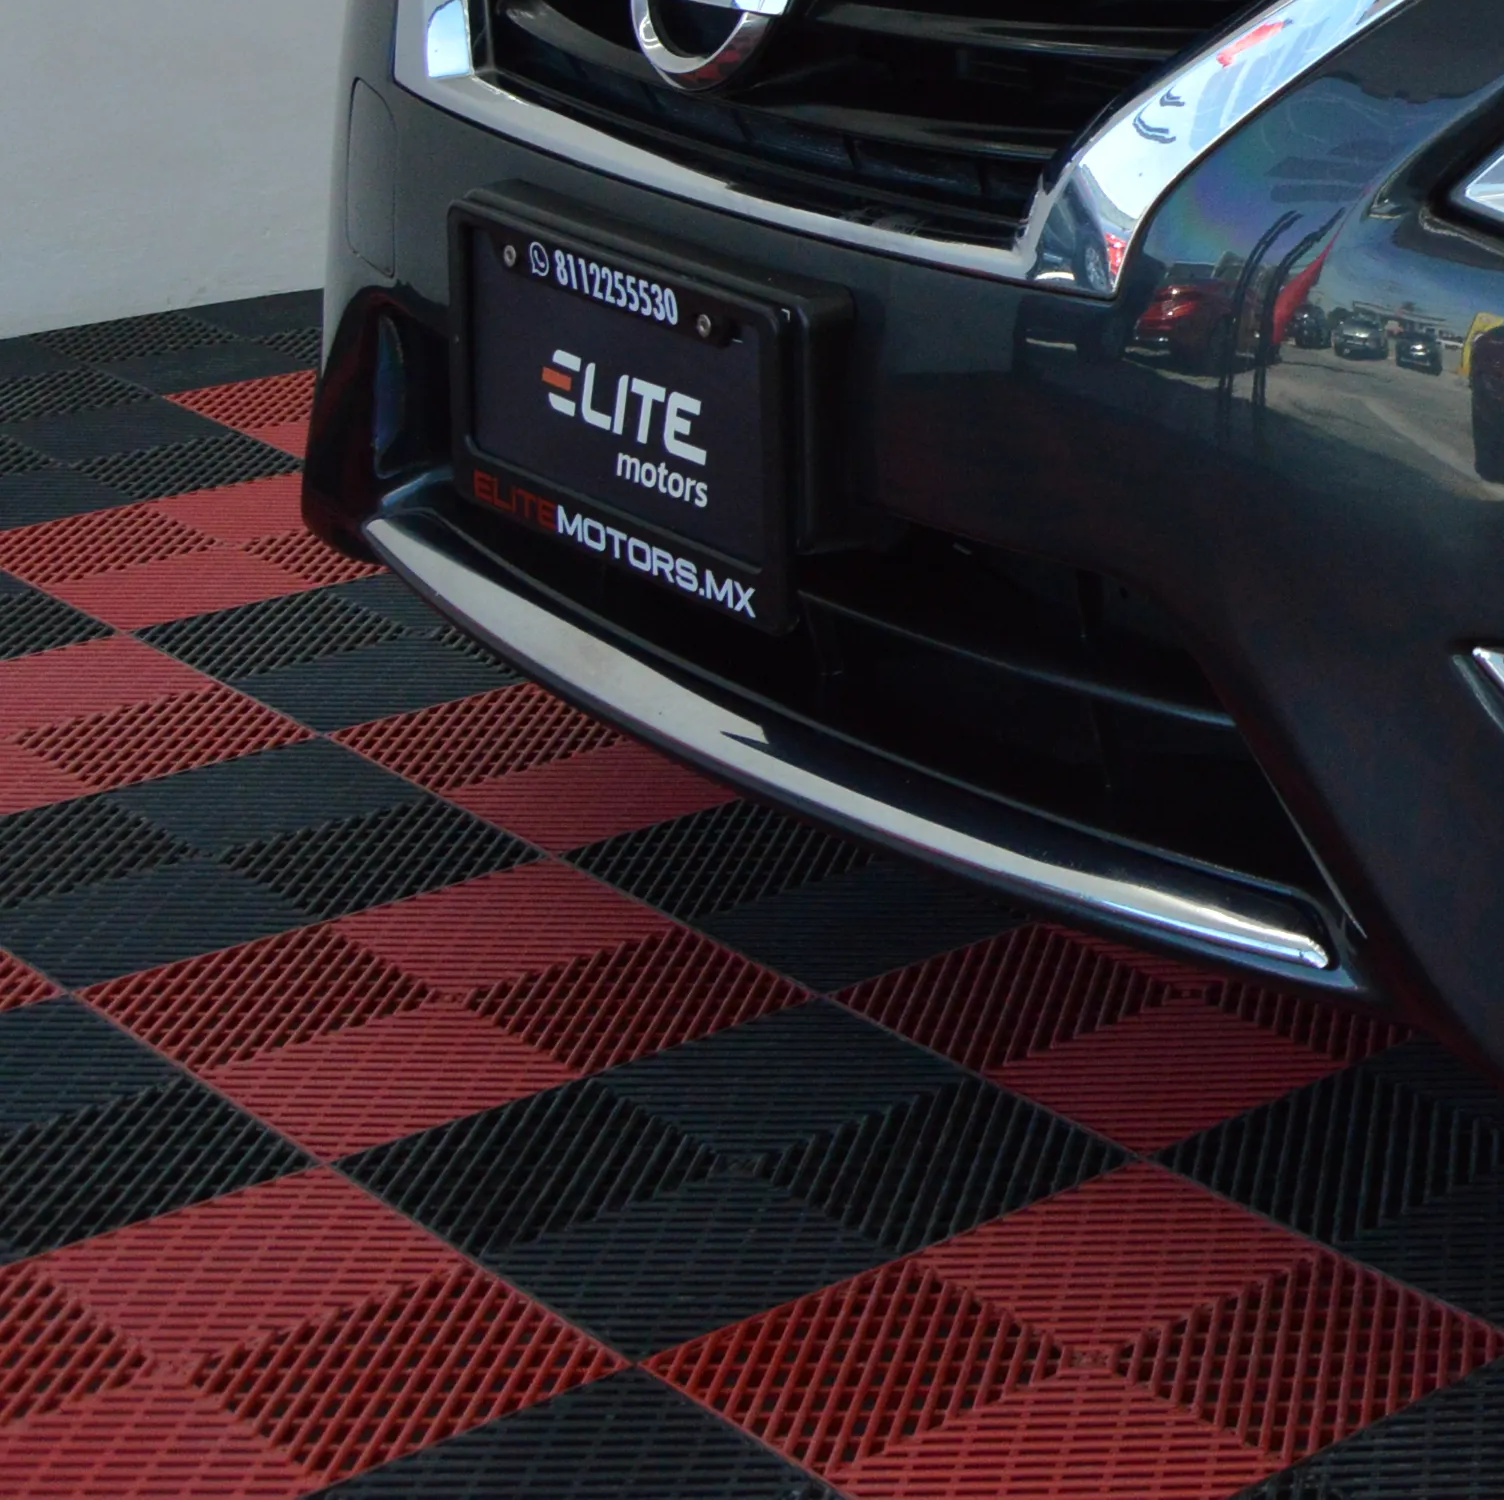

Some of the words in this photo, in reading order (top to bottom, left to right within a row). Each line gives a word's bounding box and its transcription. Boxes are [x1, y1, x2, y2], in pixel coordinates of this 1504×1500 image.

[554, 248, 679, 327] 8112255530
[541, 348, 708, 466] ELITE
[616, 451, 709, 509] motors
[473, 469, 757, 619] ELITEMOTORS.MX
